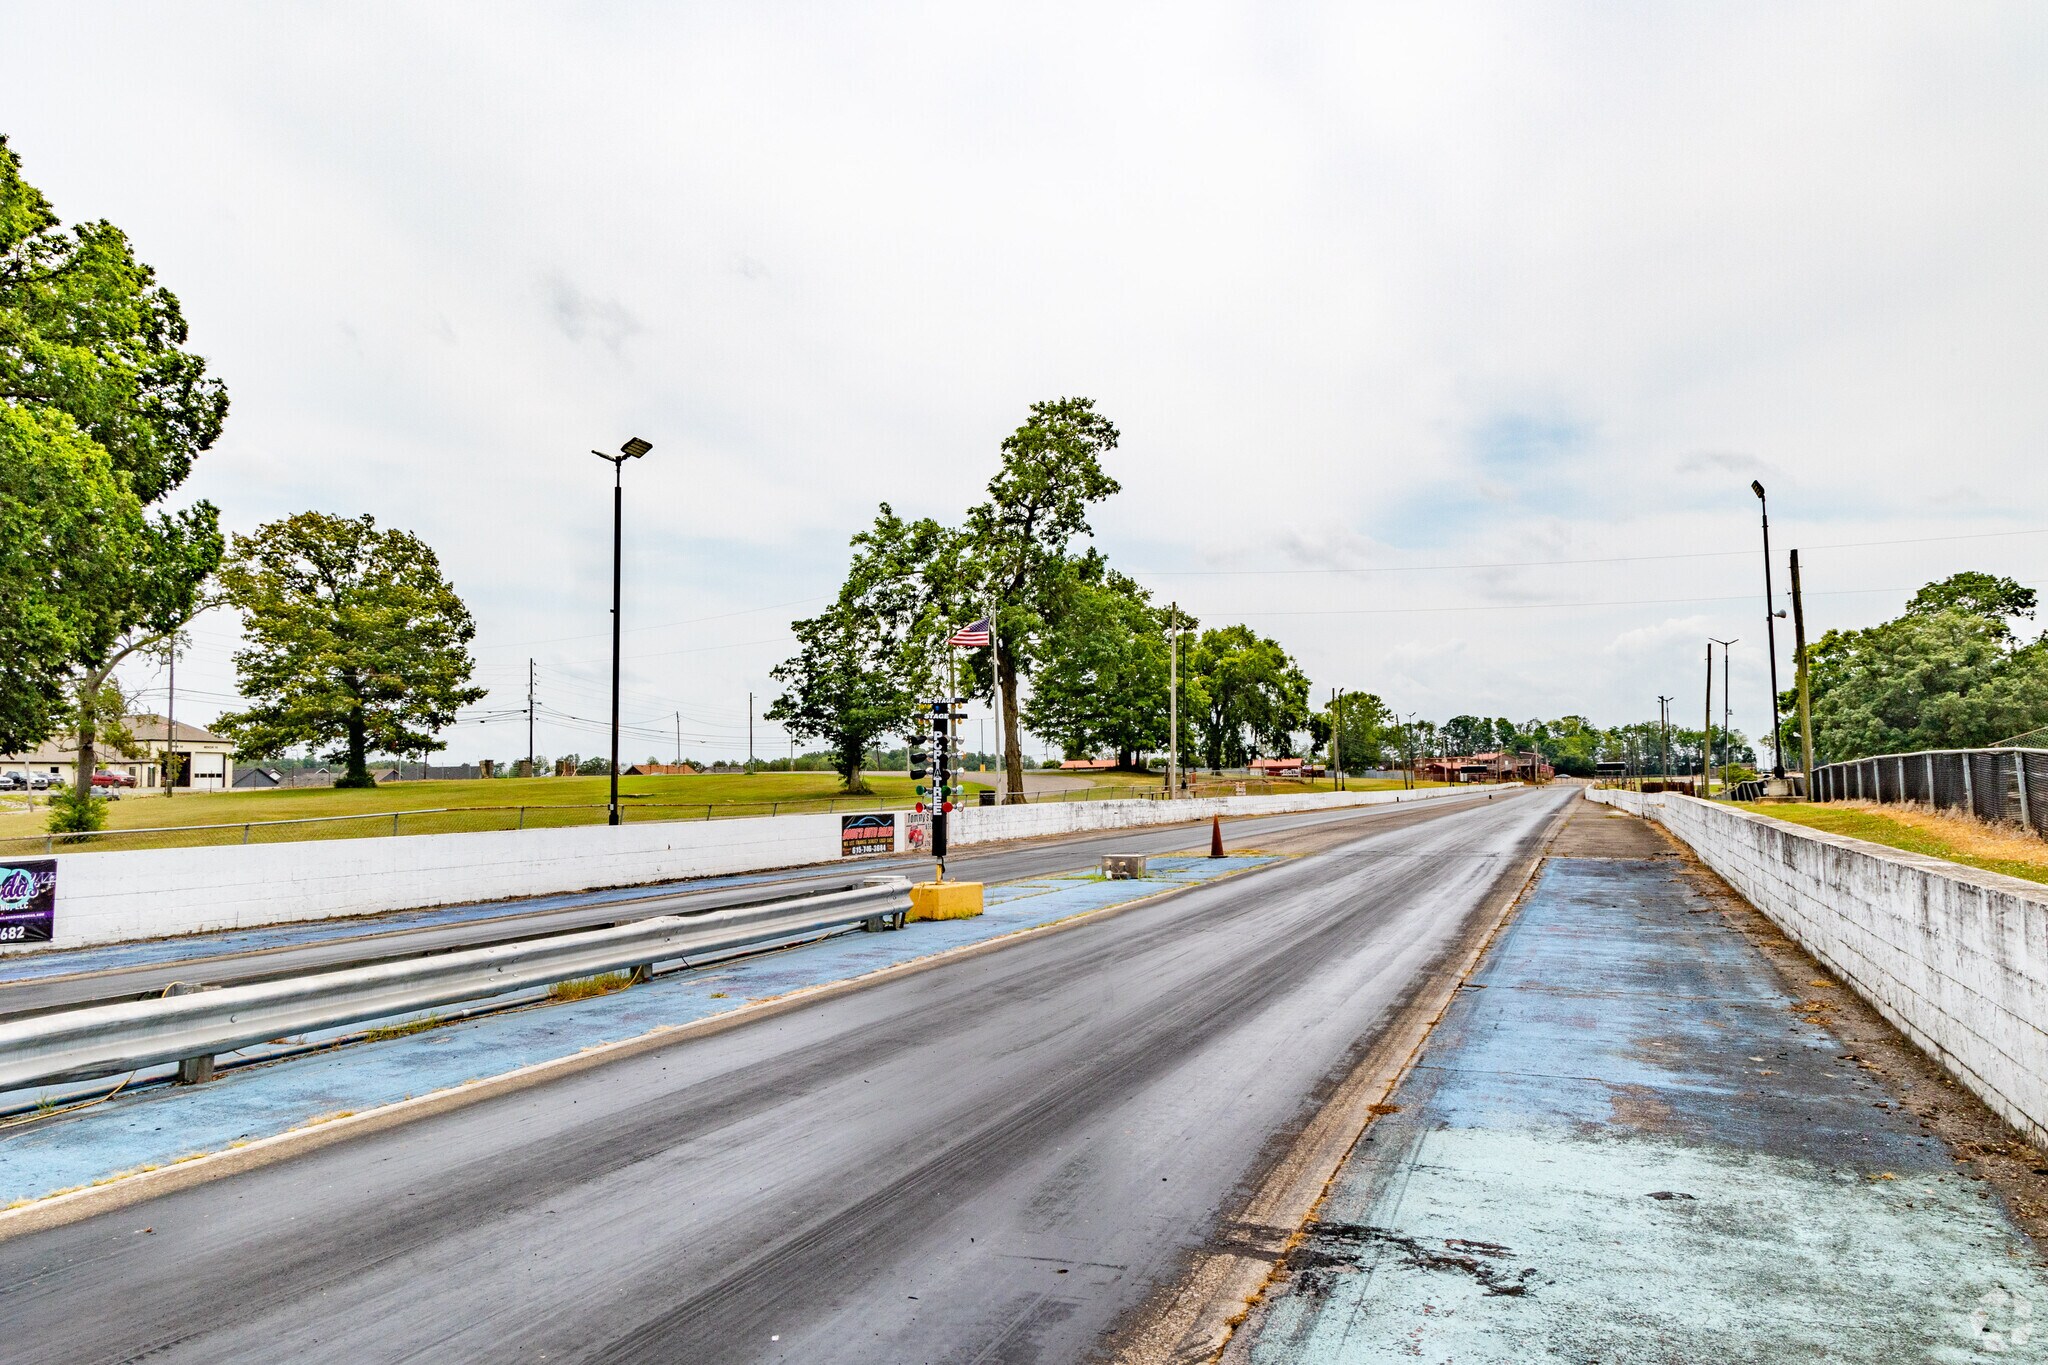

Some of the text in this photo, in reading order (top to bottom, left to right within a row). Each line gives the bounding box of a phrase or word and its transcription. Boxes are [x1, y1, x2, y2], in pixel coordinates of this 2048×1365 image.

[907, 812, 930, 824] Tommy's
[0, 870, 40, 898] da's
[15, 902, 29, 910] LLC
[0, 926, 25, 940] 682
